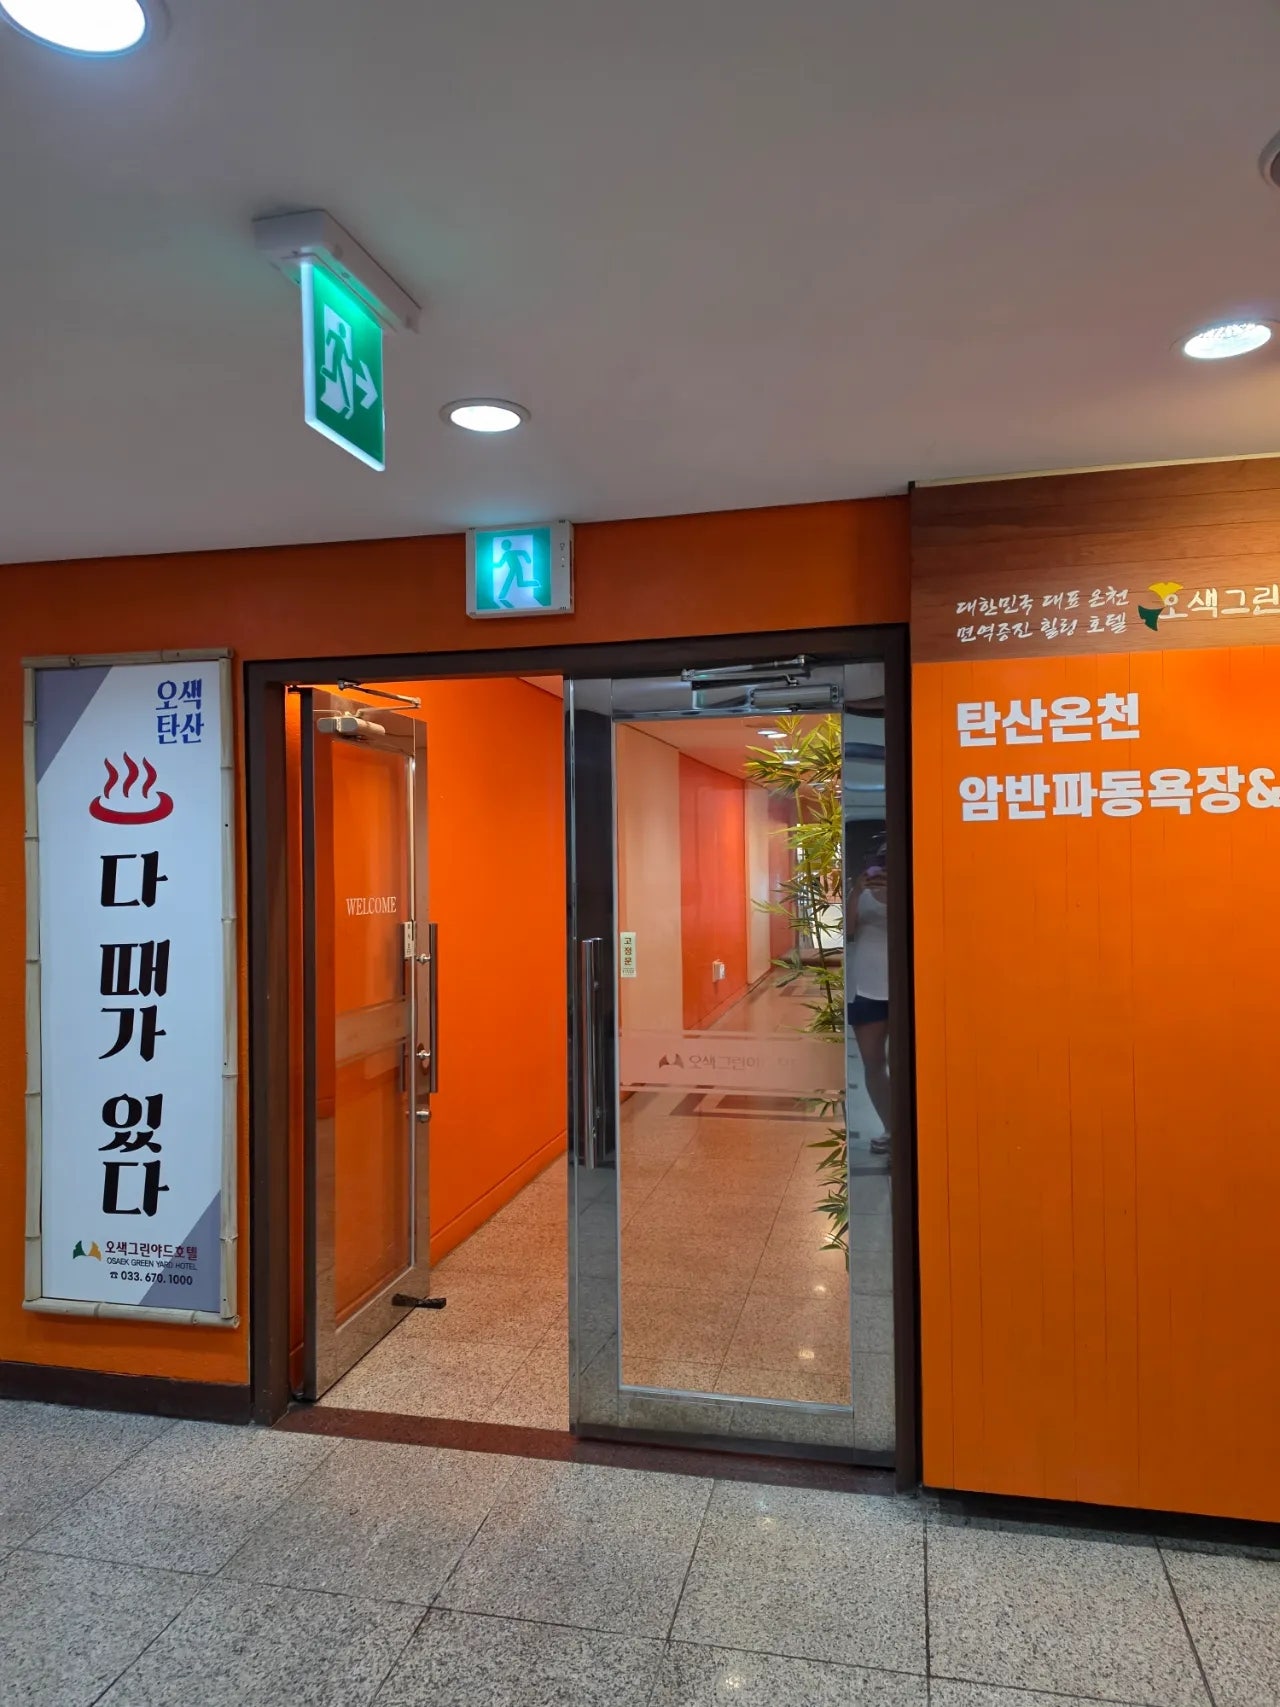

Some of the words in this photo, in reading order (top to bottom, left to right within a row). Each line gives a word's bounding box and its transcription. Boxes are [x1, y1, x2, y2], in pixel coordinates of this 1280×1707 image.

[956, 594, 1034, 616] 대한민국
[1042, 590, 1080, 610] 대표
[1088, 586, 1130, 607] 온천
[1158, 584, 1280, 619] 오색그린
[956, 622, 1034, 643] 면역증진
[1040, 617, 1078, 640] 힐링
[1087, 612, 1128, 634] 호텔
[155, 678, 203, 711] 오색
[157, 712, 205, 744] 탄산
[957, 692, 1140, 748] 탄산온천
[958, 766, 1280, 822] 암반파동욕장&
[100, 850, 169, 908] 다
[345, 896, 397, 917] WELCOME
[98, 939, 171, 1062] 때가
[98, 1093, 170, 1217] 있다
[105, 1240, 198, 1261] 오색그린야드호텔
[106, 1257, 129, 1266] OSAEK
[131, 1259, 154, 1268] GREEN
[156, 1260, 173, 1269] YARD
[175, 1262, 198, 1271] HOTEL
